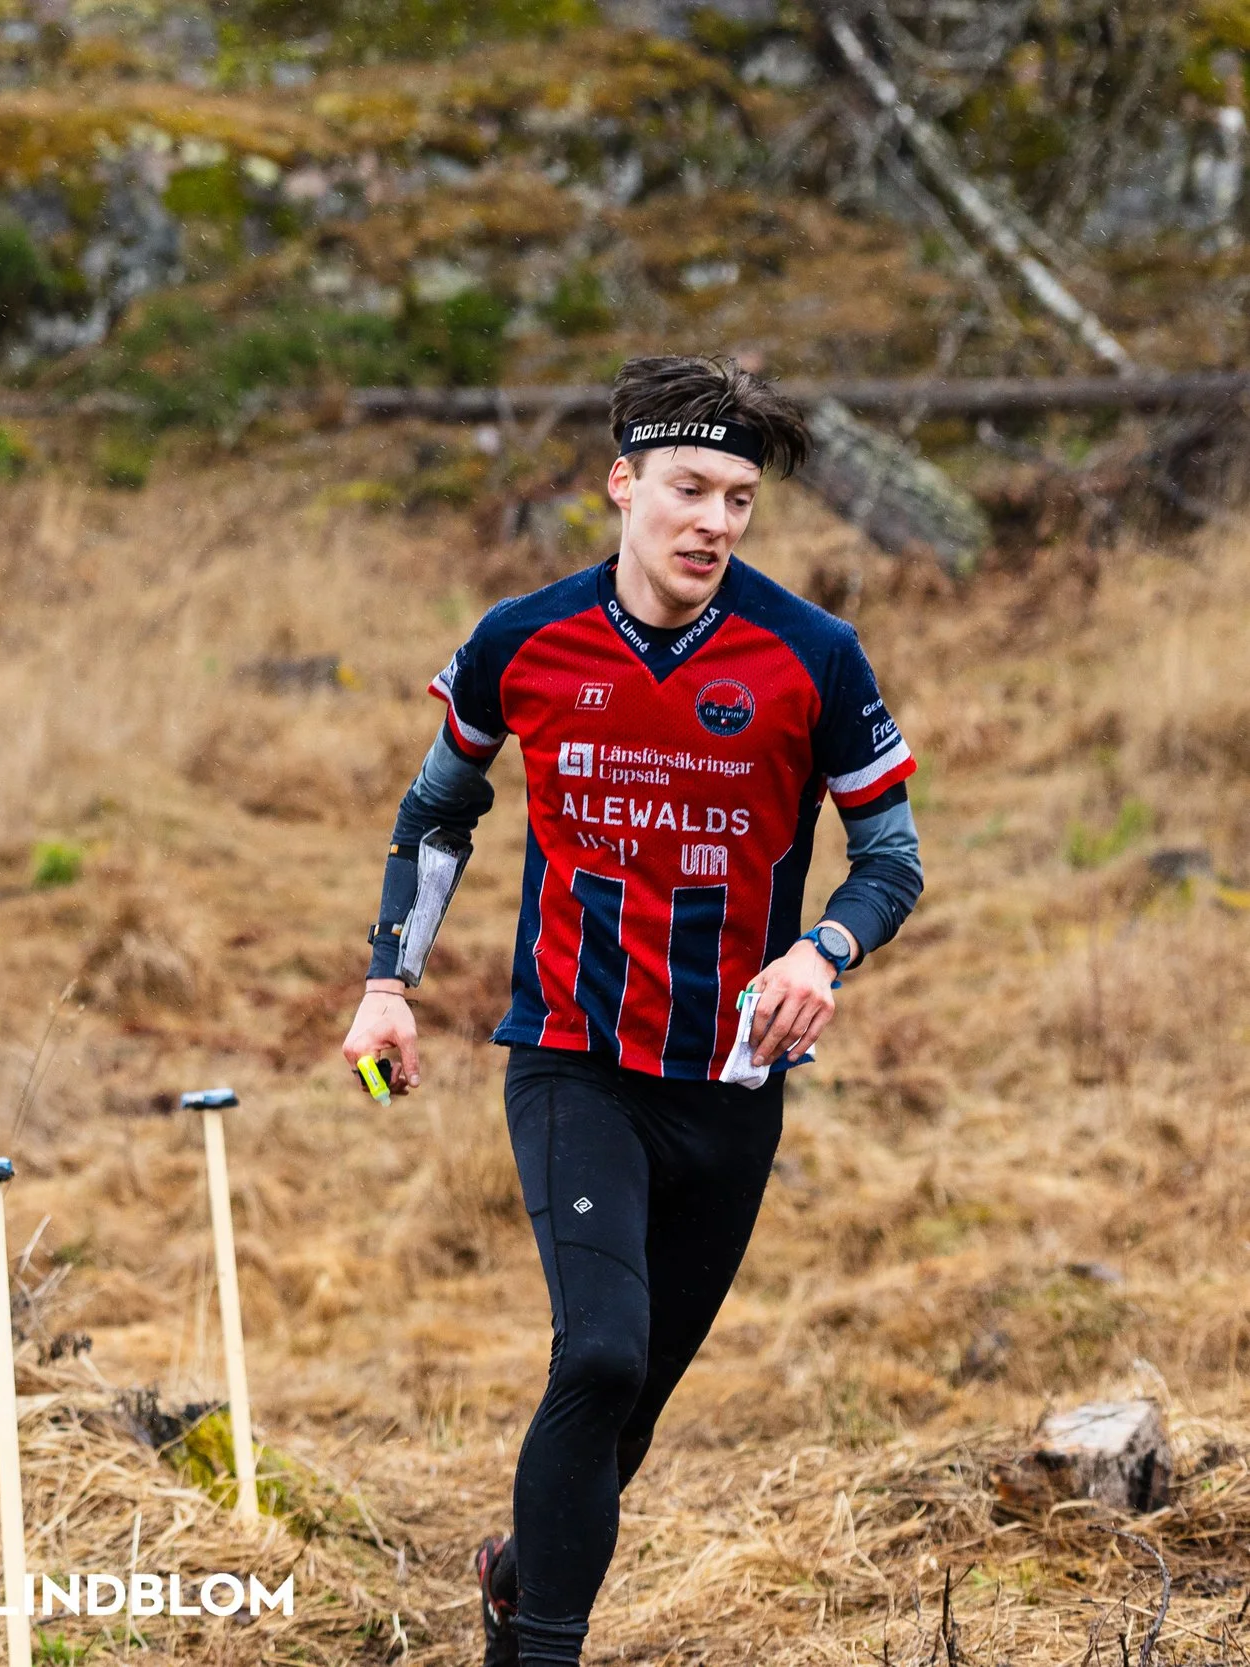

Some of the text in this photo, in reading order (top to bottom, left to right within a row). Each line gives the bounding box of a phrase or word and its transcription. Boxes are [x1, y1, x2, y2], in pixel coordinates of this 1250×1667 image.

[630, 422, 727, 443] noname
[608, 600, 650, 654] OK Linné
[670, 607, 721, 655] UPPSALA
[705, 707, 718, 717] OK
[872, 719, 897, 744] Fre
[599, 764, 670, 786] Uppsala
[600, 744, 755, 778] Länsförsäkringar
[562, 792, 750, 836] ALEWALDS
